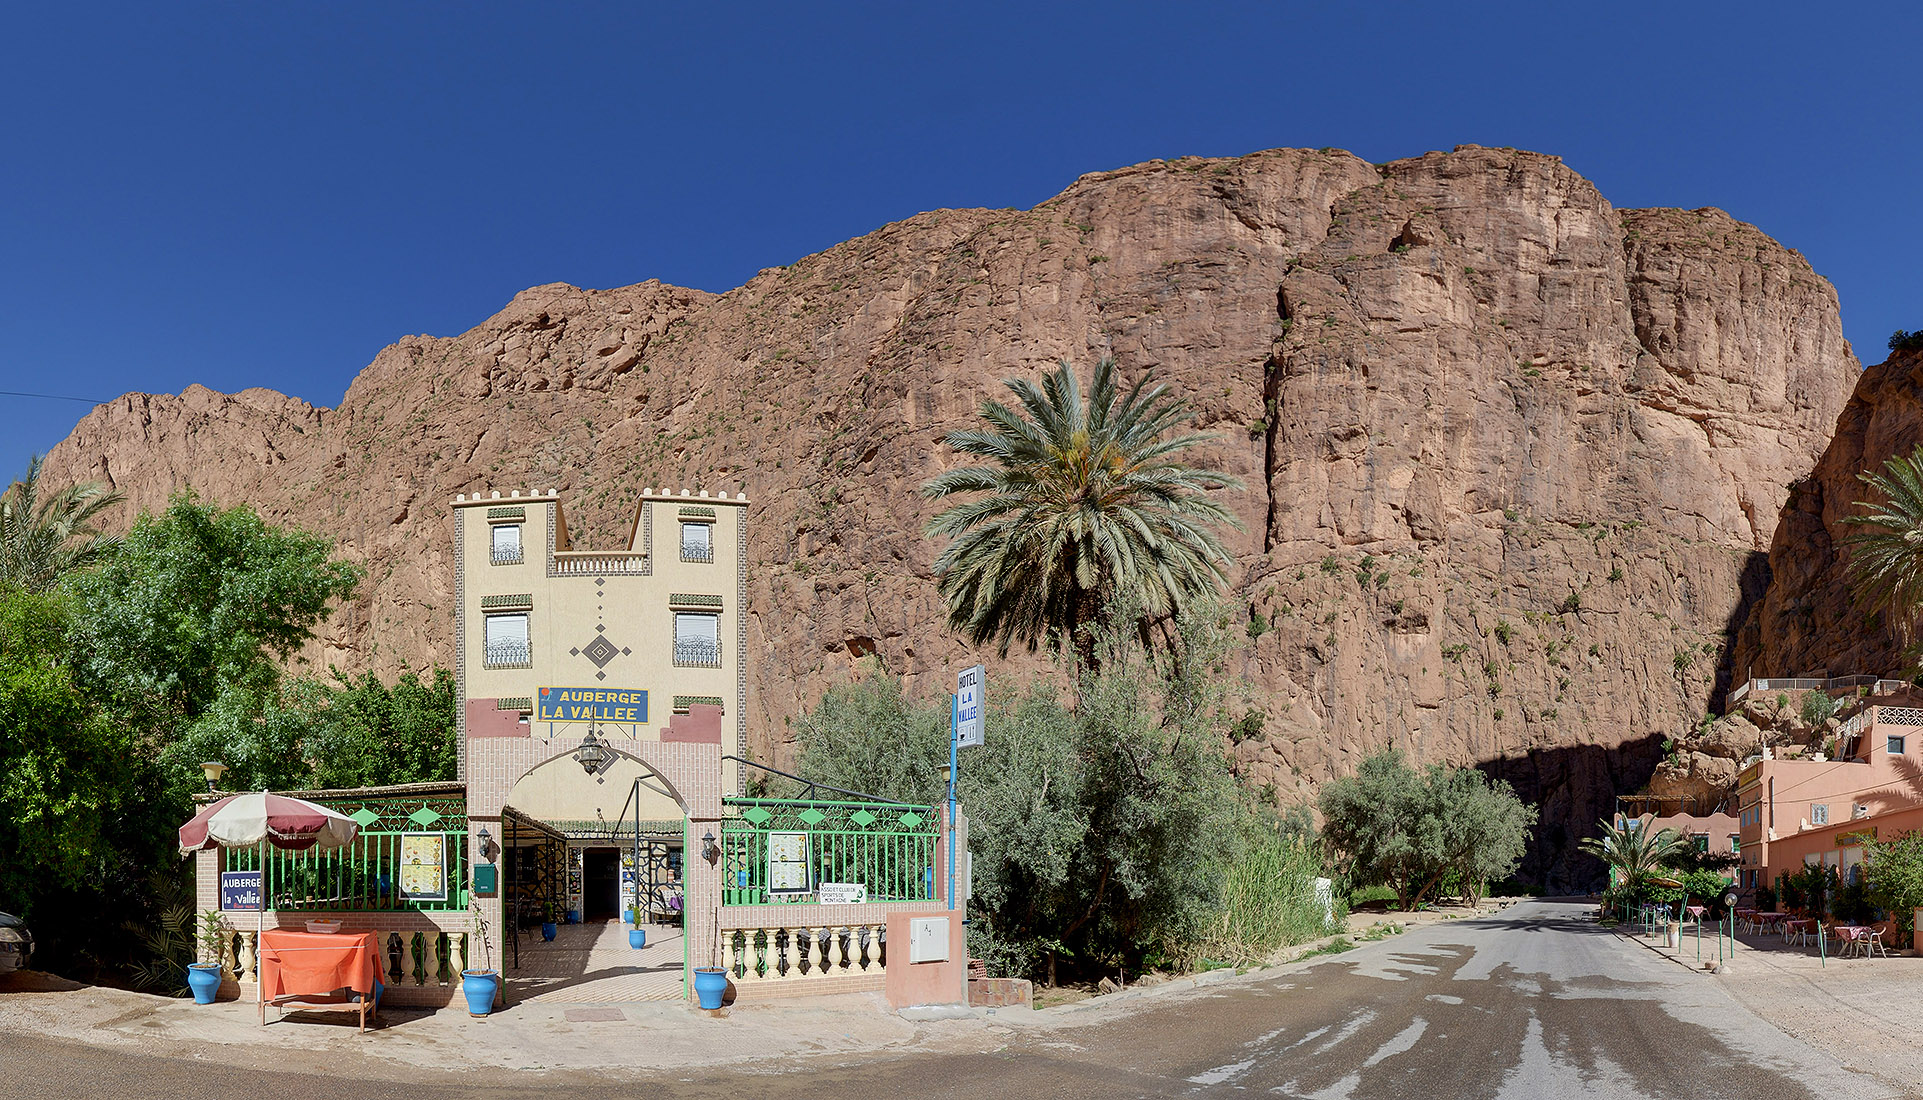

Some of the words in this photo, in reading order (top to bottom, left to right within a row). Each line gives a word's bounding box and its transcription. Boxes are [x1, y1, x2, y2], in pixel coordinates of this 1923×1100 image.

[958, 672, 977, 689] HOTEL
[559, 690, 641, 704] AUBERGE
[962, 691, 973, 704] LA
[541, 705, 564, 719] LA
[570, 706, 638, 720] VALLEE
[958, 706, 977, 723] VALLEE
[223, 878, 262, 888] AUBERGE
[224, 890, 231, 904] la
[234, 890, 261, 904] Vallée
